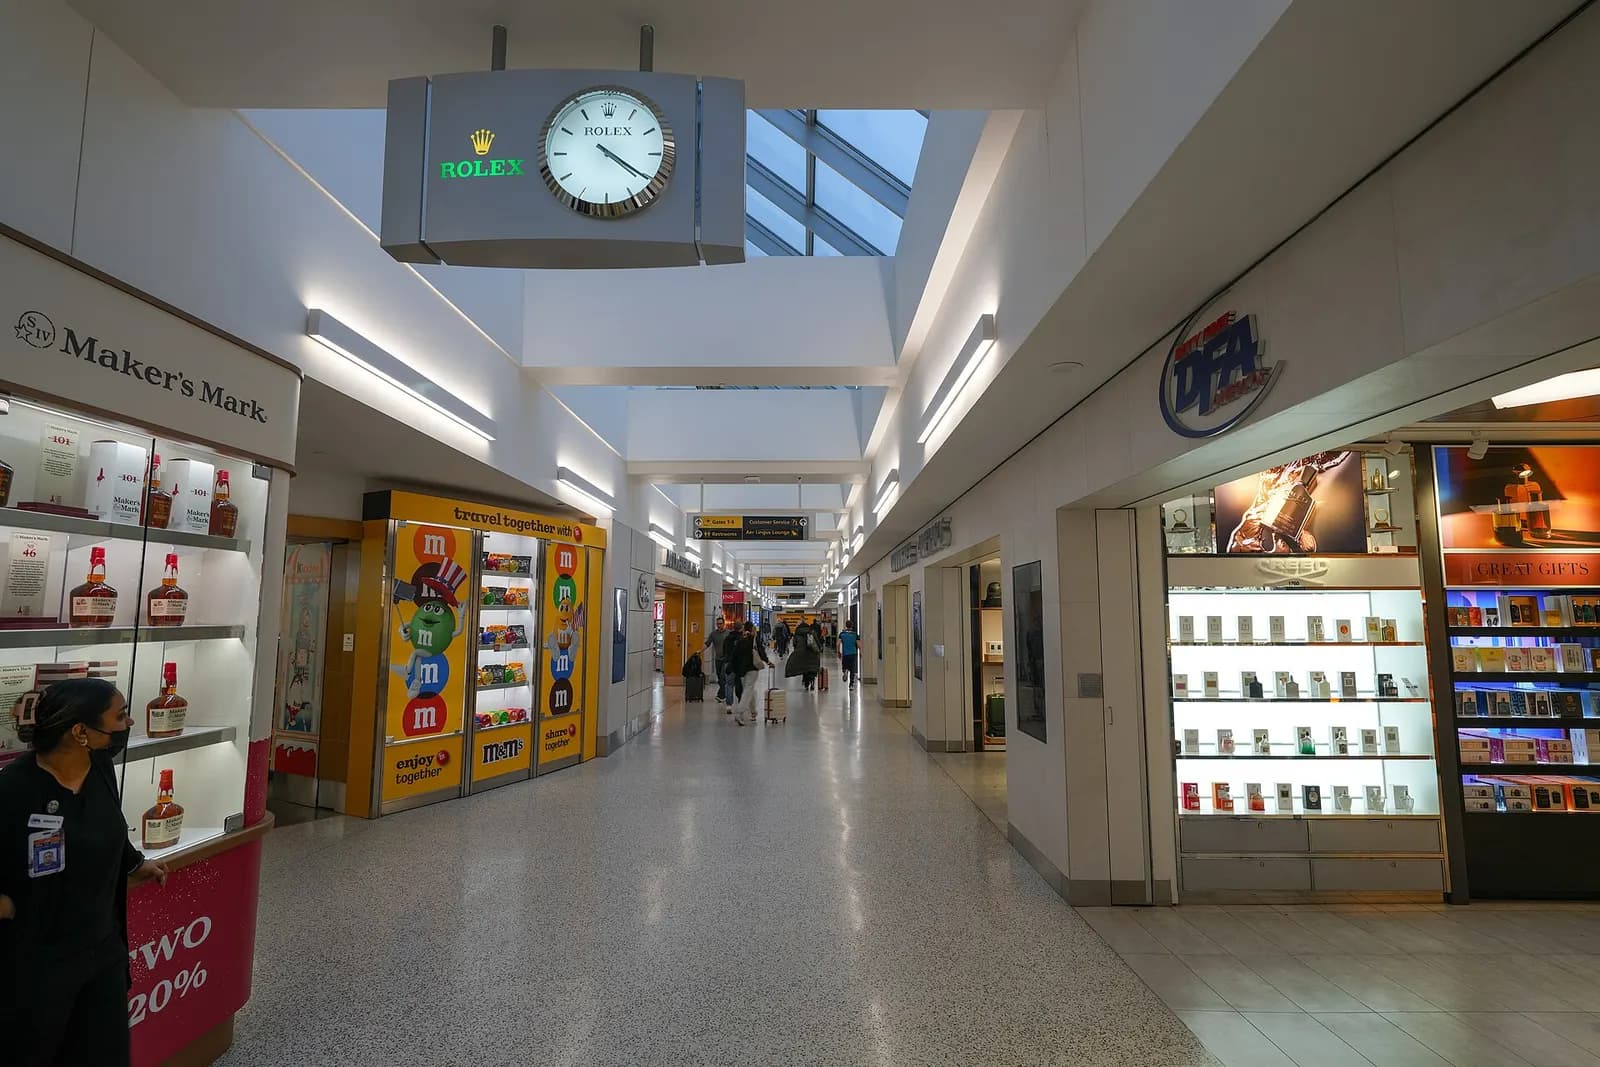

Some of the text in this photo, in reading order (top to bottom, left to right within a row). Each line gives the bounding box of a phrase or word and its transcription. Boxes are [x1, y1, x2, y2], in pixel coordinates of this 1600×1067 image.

[584, 126, 632, 136] ROLEX
[440, 159, 525, 179] ROLEX
[27, 316, 36, 328] S
[36, 328, 50, 341] IV
[1174, 314, 1261, 416] DFA
[59, 327, 267, 424] Maker's Mark
[454, 507, 501, 526] travel
[503, 515, 555, 533] together
[557, 524, 573, 537] with
[22, 548, 37, 558] 46
[423, 534, 446, 556] m
[560, 551, 572, 568] m
[1477, 561, 1589, 576] GREAT GIFTS
[418, 629, 433, 647] m
[556, 654, 569, 672] m
[420, 663, 439, 684] m
[555, 689, 568, 708] m
[413, 706, 437, 730] m
[545, 729, 568, 740] share
[545, 737, 570, 752] together
[396, 754, 435, 770] enjoy
[395, 767, 442, 785] together
[128, 960, 207, 1029] 20%
